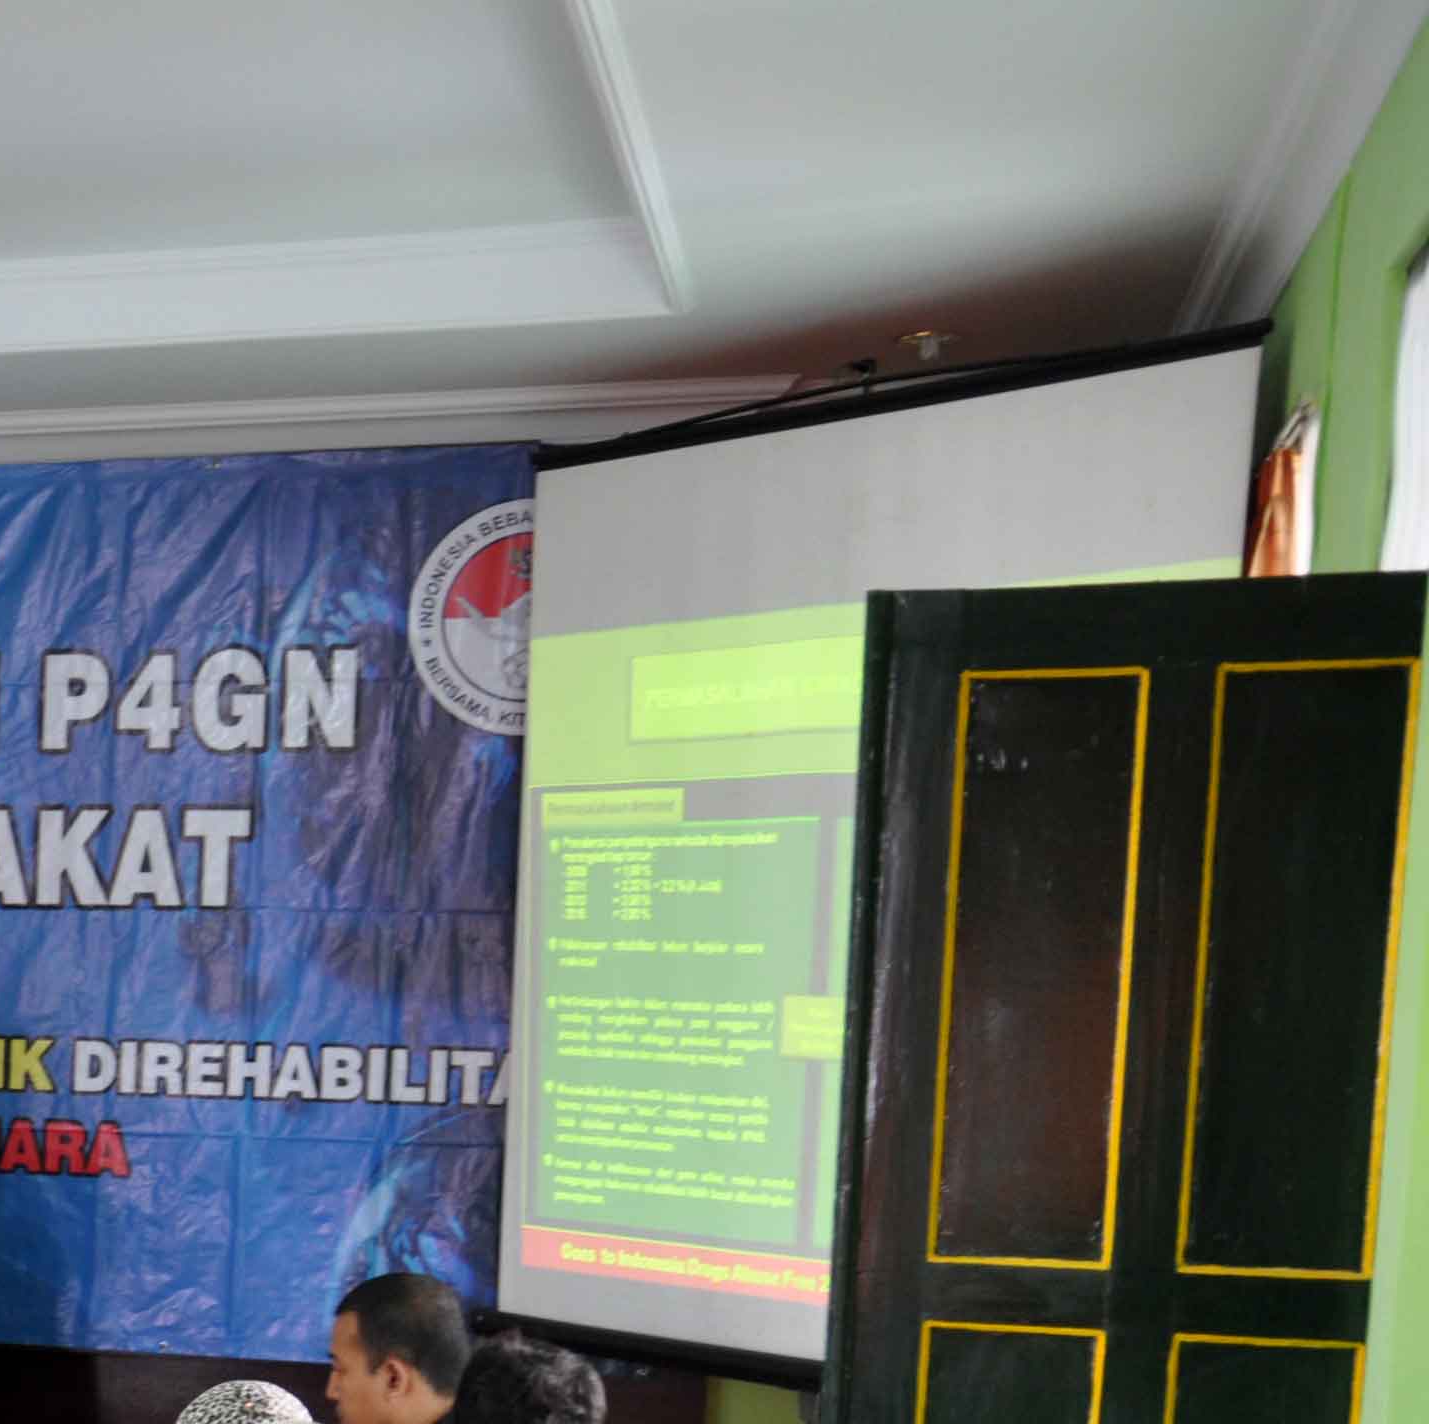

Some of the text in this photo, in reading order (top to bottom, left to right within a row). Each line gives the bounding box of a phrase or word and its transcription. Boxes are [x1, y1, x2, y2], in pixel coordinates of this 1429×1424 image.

[420, 511, 533, 630] INDONESIA BEBA
[40, 643, 361, 757] P4GN
[498, 711, 526, 729] KIT
